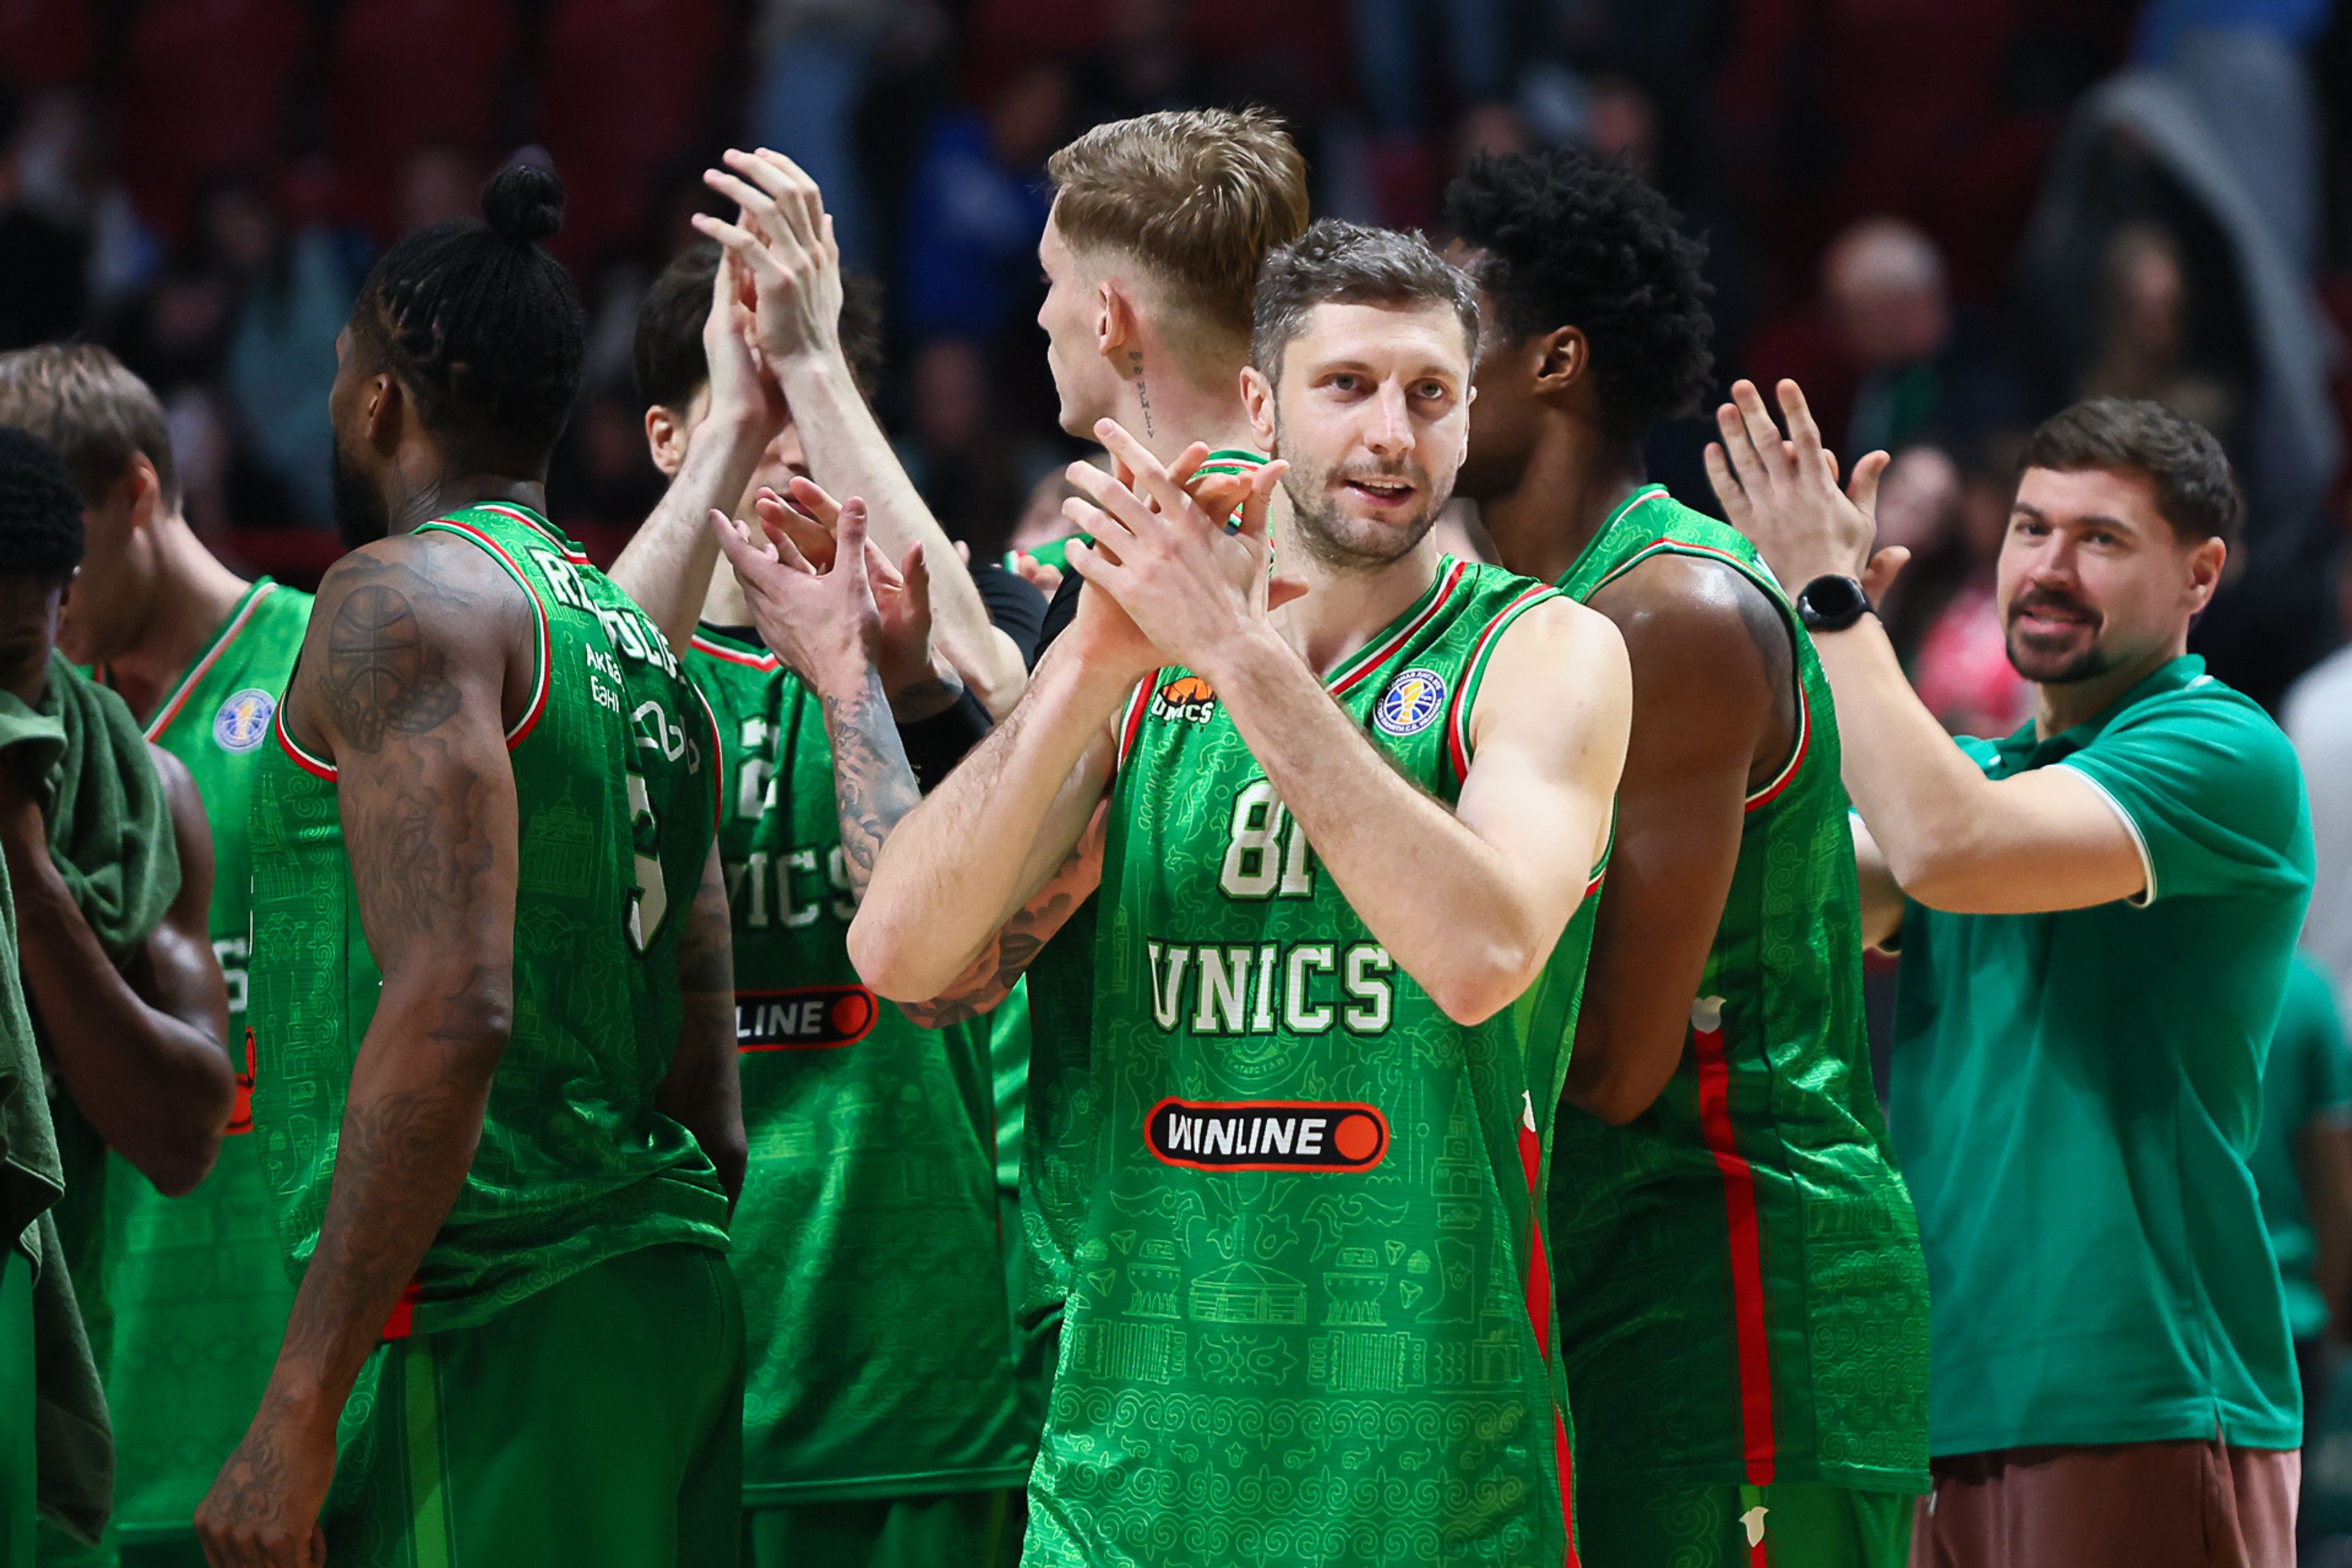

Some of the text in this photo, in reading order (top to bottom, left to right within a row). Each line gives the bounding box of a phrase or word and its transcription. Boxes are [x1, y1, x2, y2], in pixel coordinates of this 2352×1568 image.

[1218, 778, 1314, 901] 81
[736, 1001, 824, 1039] LINE
[1146, 939, 1395, 1035] UNICS
[1168, 1113, 1327, 1155] WINLINE
